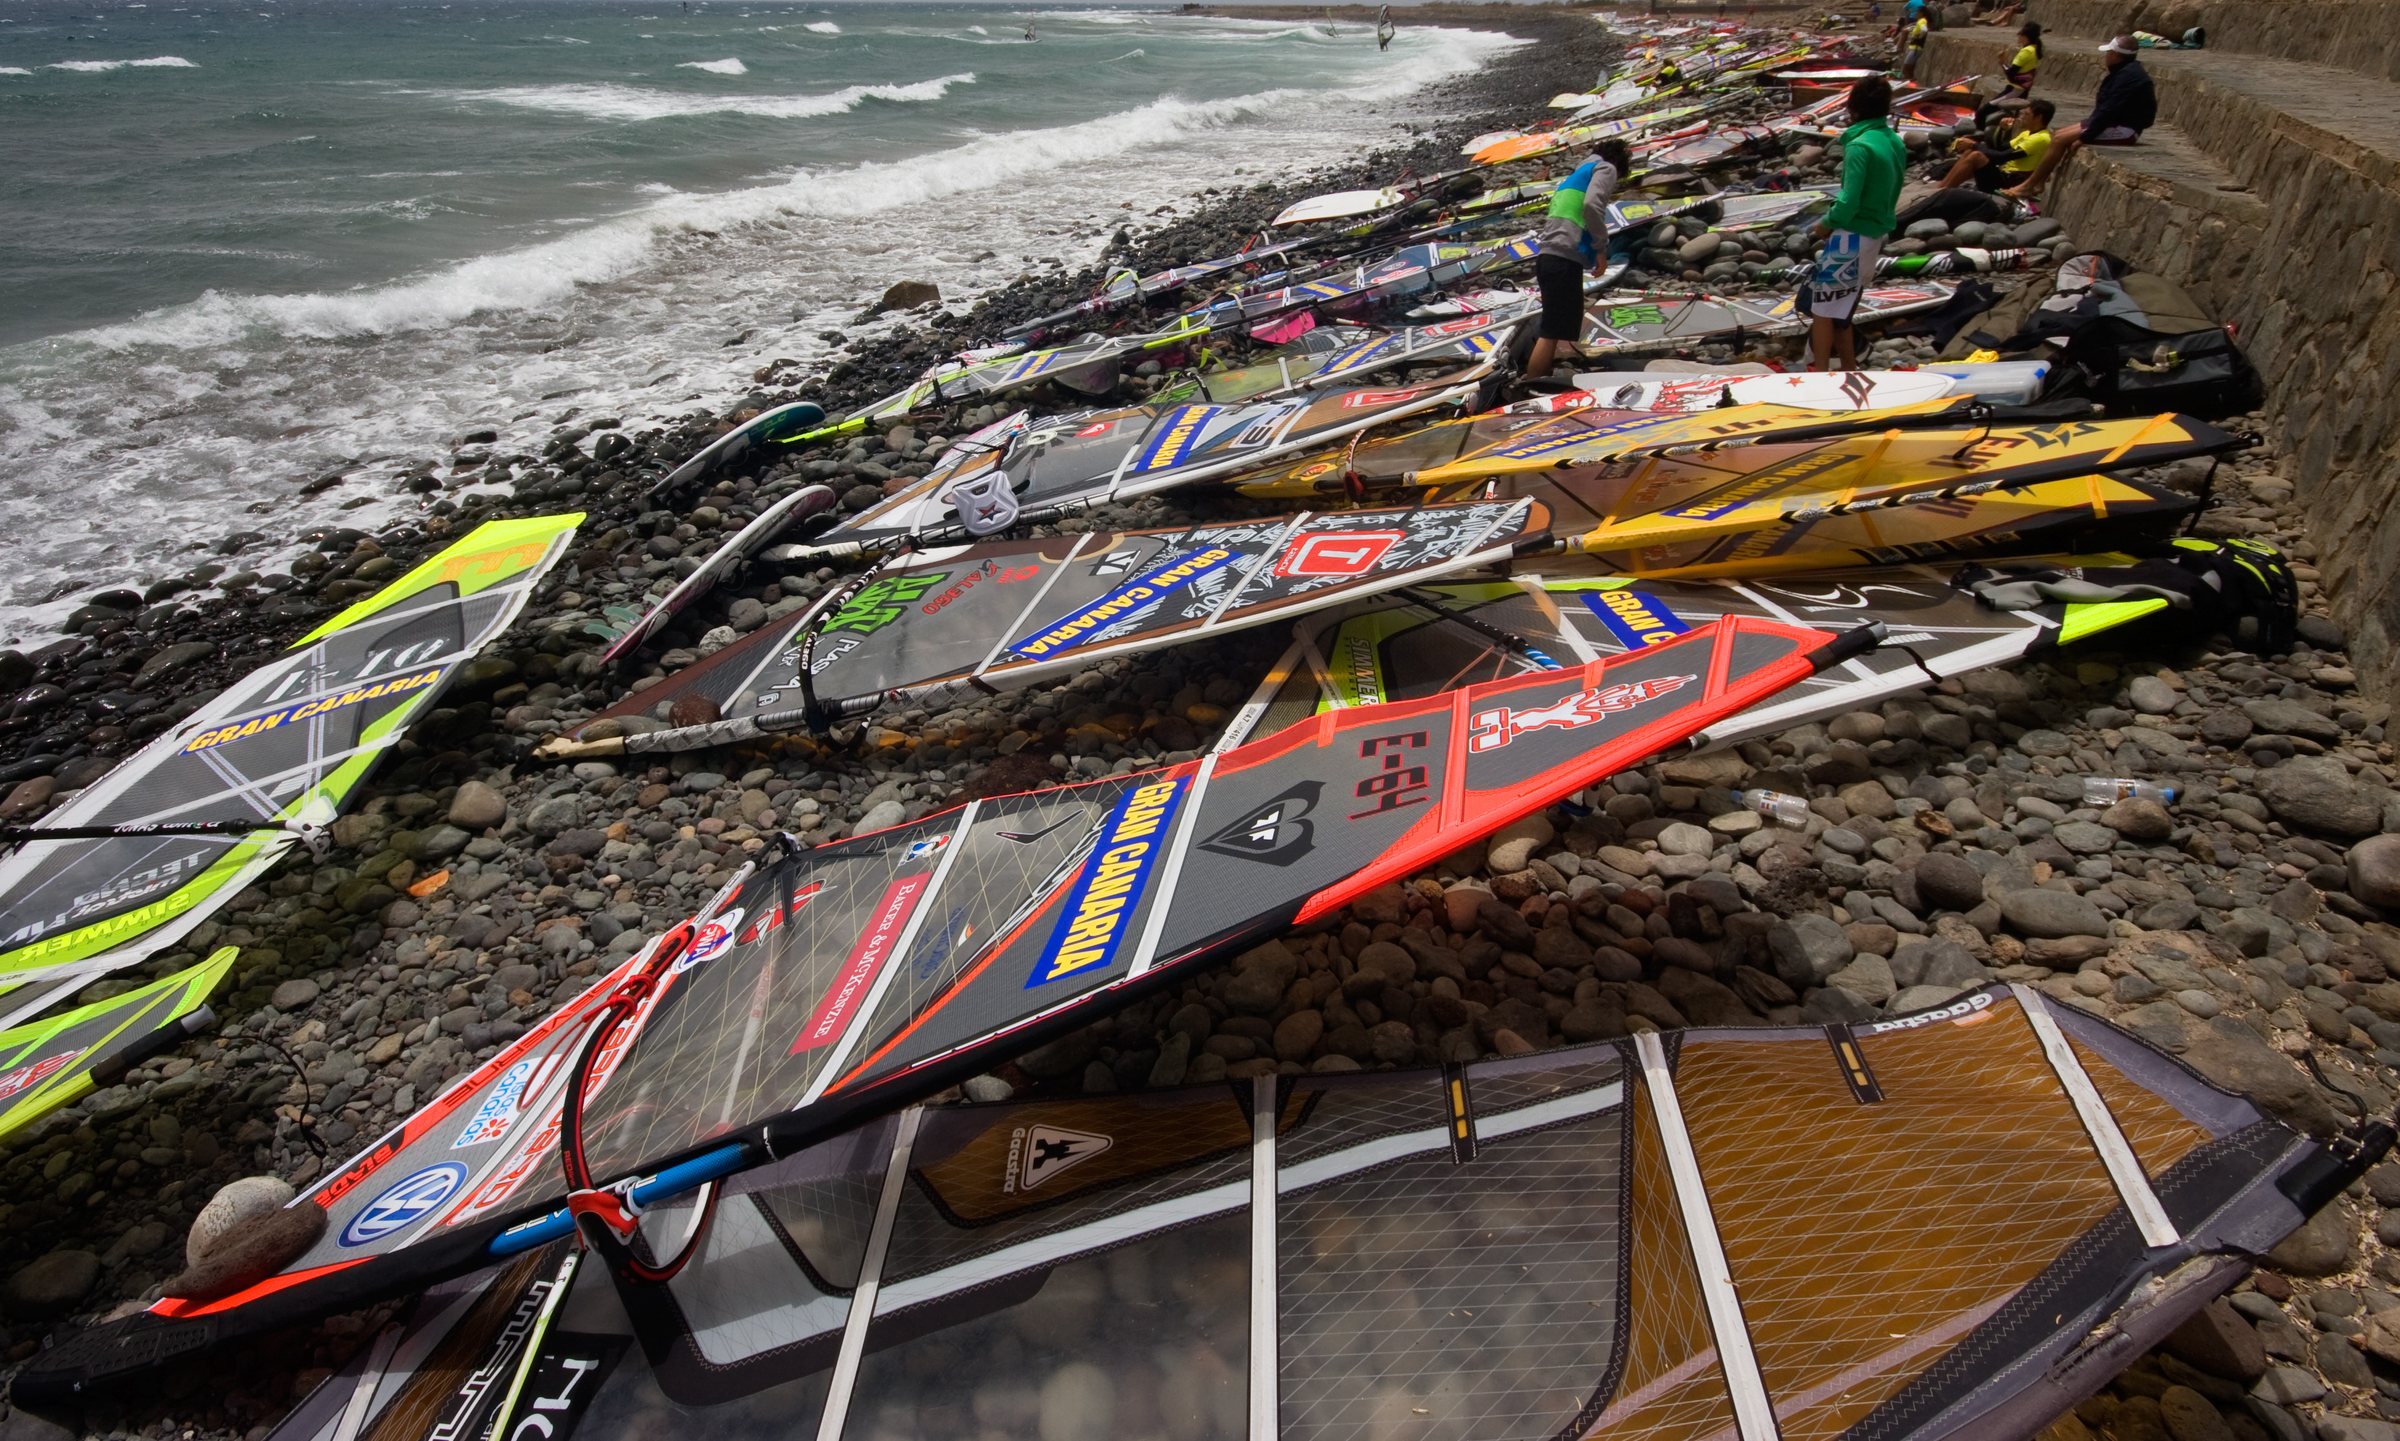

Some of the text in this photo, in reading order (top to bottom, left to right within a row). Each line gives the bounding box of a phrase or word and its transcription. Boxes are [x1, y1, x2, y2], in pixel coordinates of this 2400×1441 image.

[1149, 421, 1195, 469] CANARIA
[1502, 427, 1617, 459] CANARIA
[1676, 453, 1847, 517] GRAN CANARIA
[1020, 549, 1230, 655] GRAN CANARIA
[1599, 591, 1657, 632] GRAN
[768, 639, 860, 690] PLASA
[186, 669, 443, 753] GRAN CANARIA
[1111, 781, 1177, 843] GRAN
[876, 882, 917, 934] BAKER
[1046, 841, 1150, 980] CANARIA
[872, 934, 887, 947] &
[1874, 991, 1994, 1032] Gaastra
[456, 1062, 529, 1147] Canarias
[1003, 1127, 1026, 1193] Gaastra
